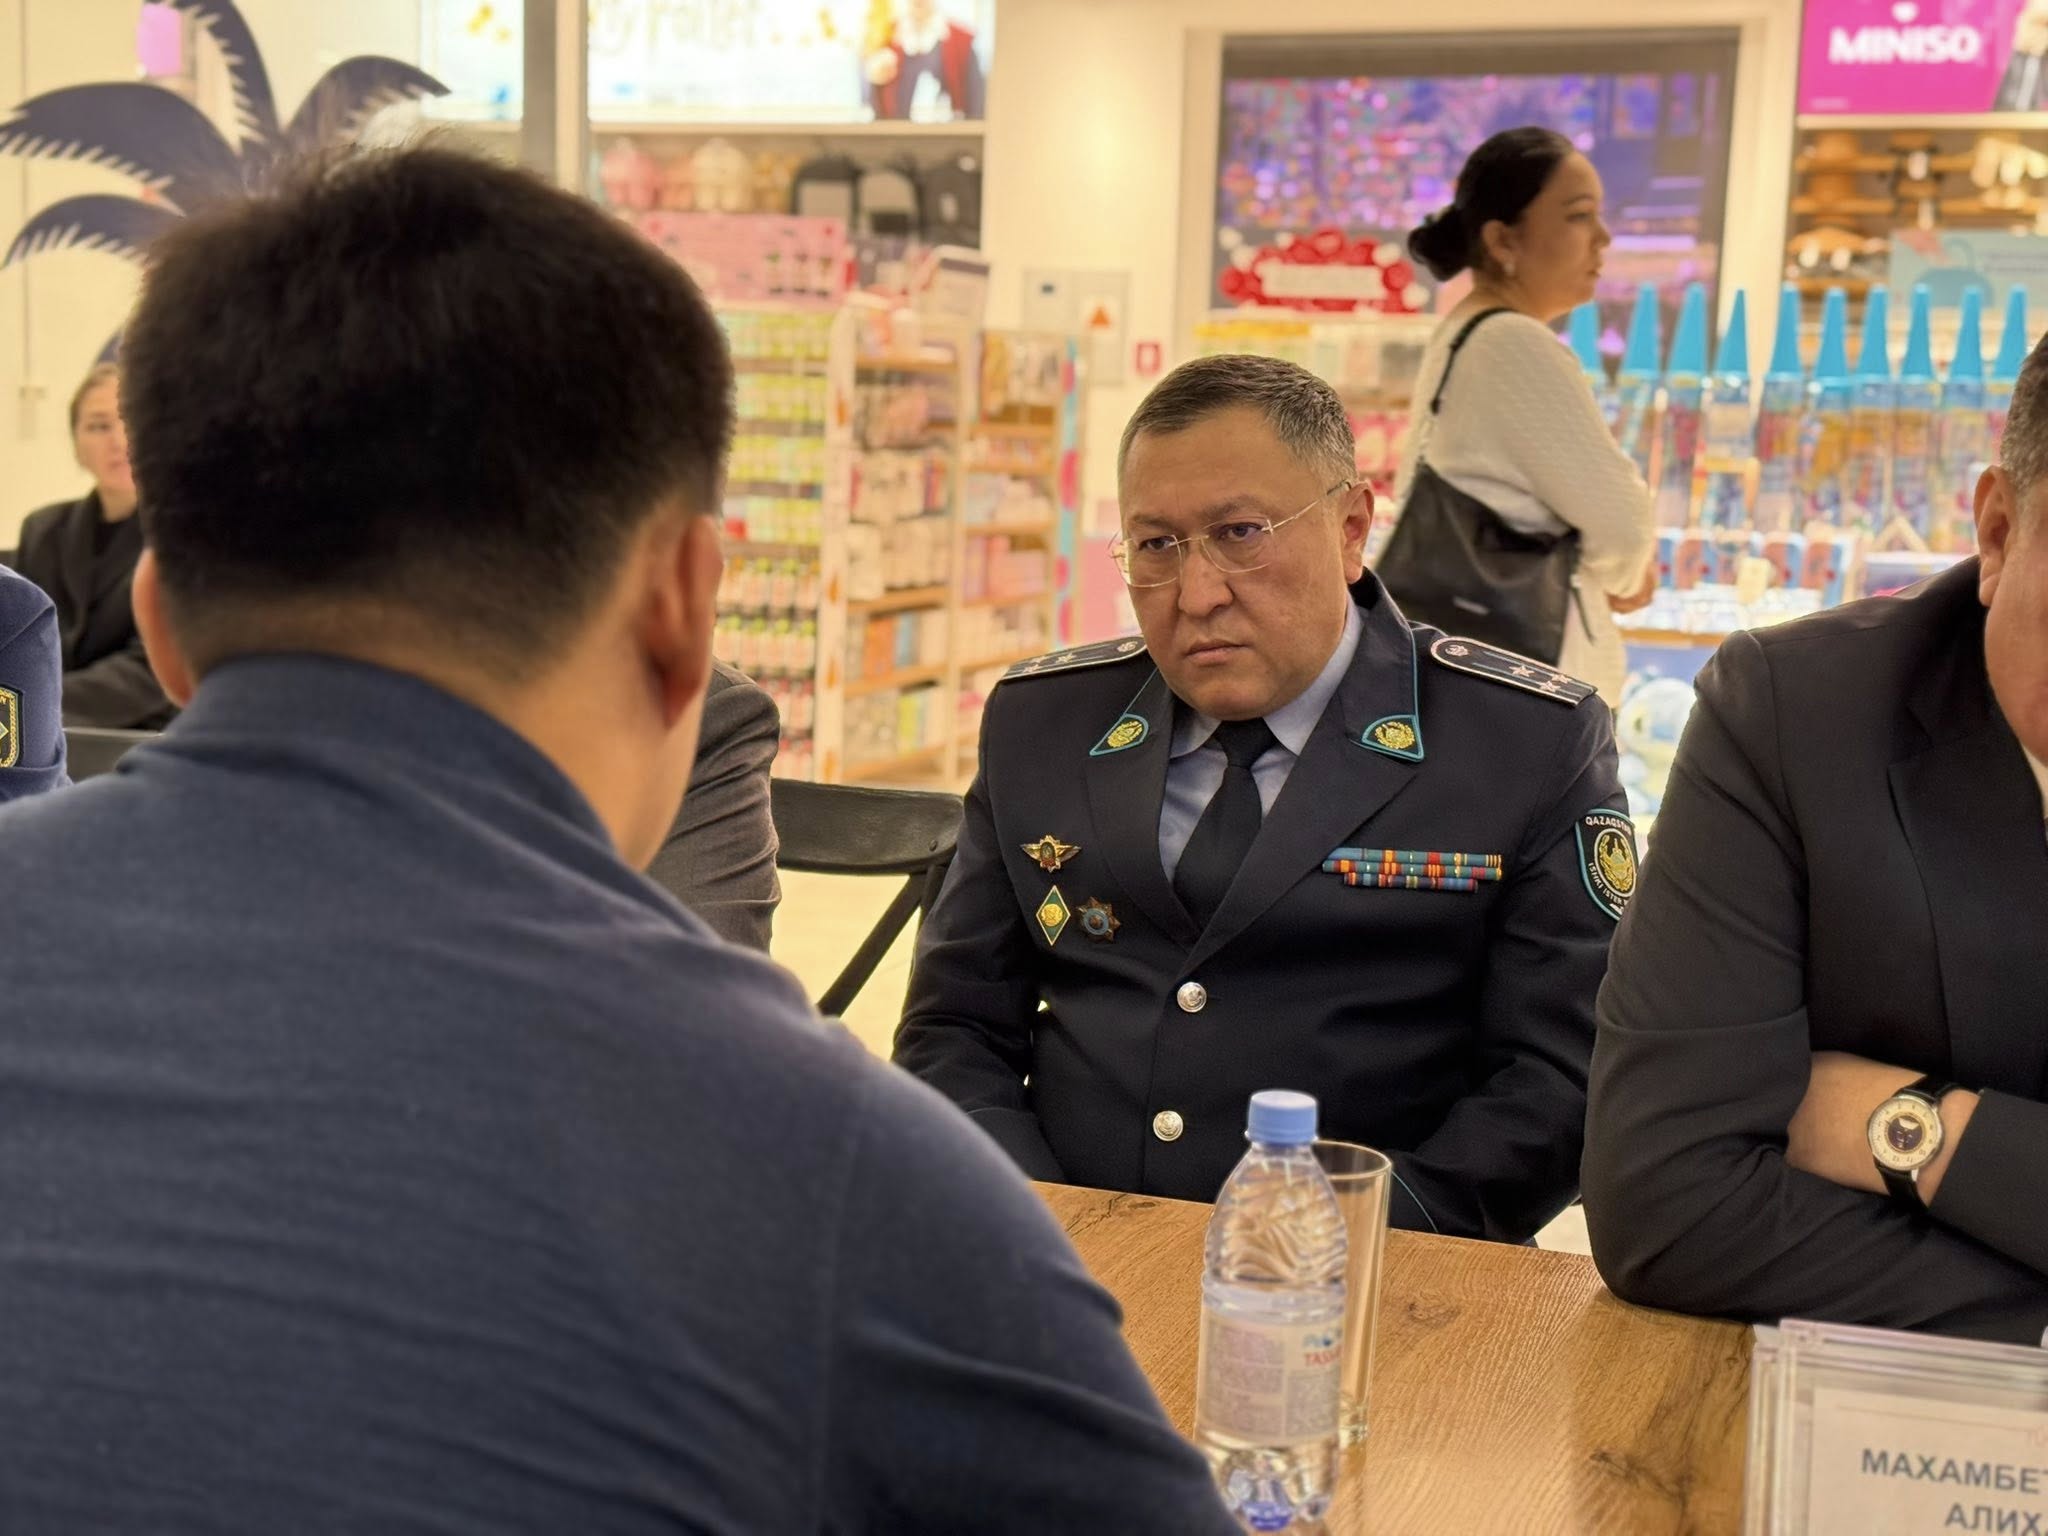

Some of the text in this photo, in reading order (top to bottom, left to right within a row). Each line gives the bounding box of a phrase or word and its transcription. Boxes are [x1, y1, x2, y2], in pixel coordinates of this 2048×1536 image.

[1829, 26, 1980, 63] MINISO
[1862, 1448, 2048, 1495] МАХАМБЕ
[1945, 1503, 2048, 1536] АЛИХ
